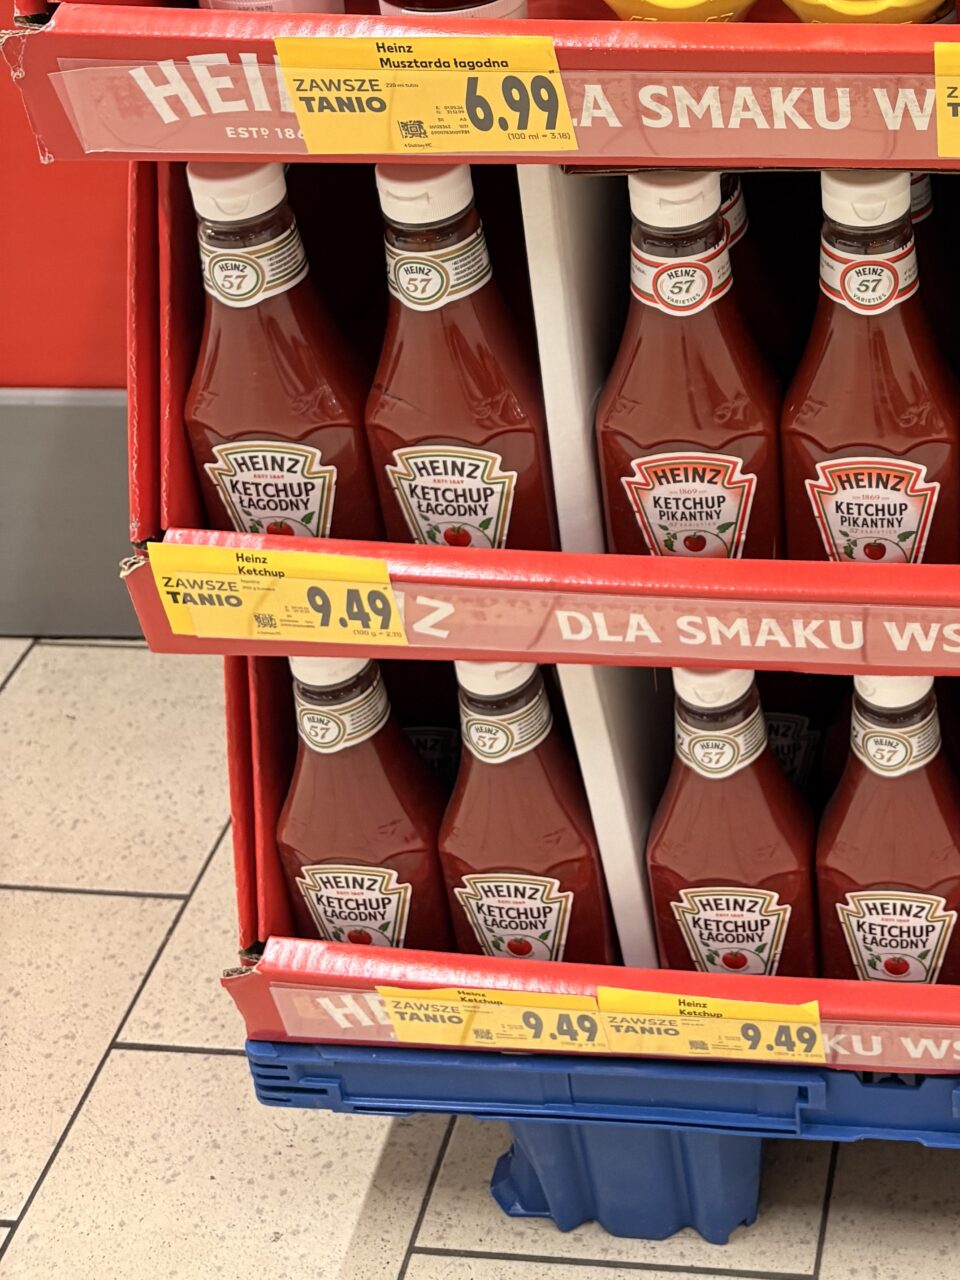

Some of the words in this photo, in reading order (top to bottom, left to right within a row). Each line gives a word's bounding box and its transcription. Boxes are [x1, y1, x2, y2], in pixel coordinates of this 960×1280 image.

[376, 42, 413, 54] Heinz
[380, 59, 450, 68] Musztarda
[454, 58, 508, 70] łagodna
[129, 53, 297, 124] HEI
[293, 79, 382, 92] ZAWSZE
[299, 97, 387, 113] TANIO
[466, 75, 558, 131] 6.99
[551, 132, 570, 140] 3.18)
[219, 262, 247, 273] HEINZ
[667, 270, 697, 279] HEINZ
[221, 275, 248, 291] 57
[670, 279, 695, 295] 57
[234, 455, 301, 474] HEINZ
[413, 460, 480, 479] HEINZ
[652, 467, 721, 486] HEINZ
[230, 480, 316, 498] KETCHUP
[408, 485, 495, 504] KETCHUP
[239, 495, 310, 511] ŁAGODNY
[417, 500, 488, 517] ŁAGODNY
[652, 495, 726, 512] KETCHUP
[659, 510, 722, 522] PIKANTNY
[236, 553, 268, 564] Heinz
[238, 567, 285, 578] Ketchup
[162, 577, 240, 592] ZAWSZE
[166, 592, 243, 607] TANIO
[307, 586, 391, 629] 9.49
[560, 611, 662, 644] DLA
[674, 617, 865, 652] SMAKU
[480, 883, 540, 900] HEINZ
[476, 904, 553, 920] KETCHUP
[483, 917, 548, 930] ŁAGODNY
[392, 1000, 460, 1013] ZAWSZE
[678, 999, 707, 1009] Heinz
[395, 1011, 463, 1024] TANIO
[608, 1016, 678, 1026] ZAWSZE
[679, 1009, 723, 1018] Ketchup
[522, 1010, 598, 1041] 9.49
[610, 1025, 680, 1036] TANIO
[740, 1023, 816, 1053] 9.49
